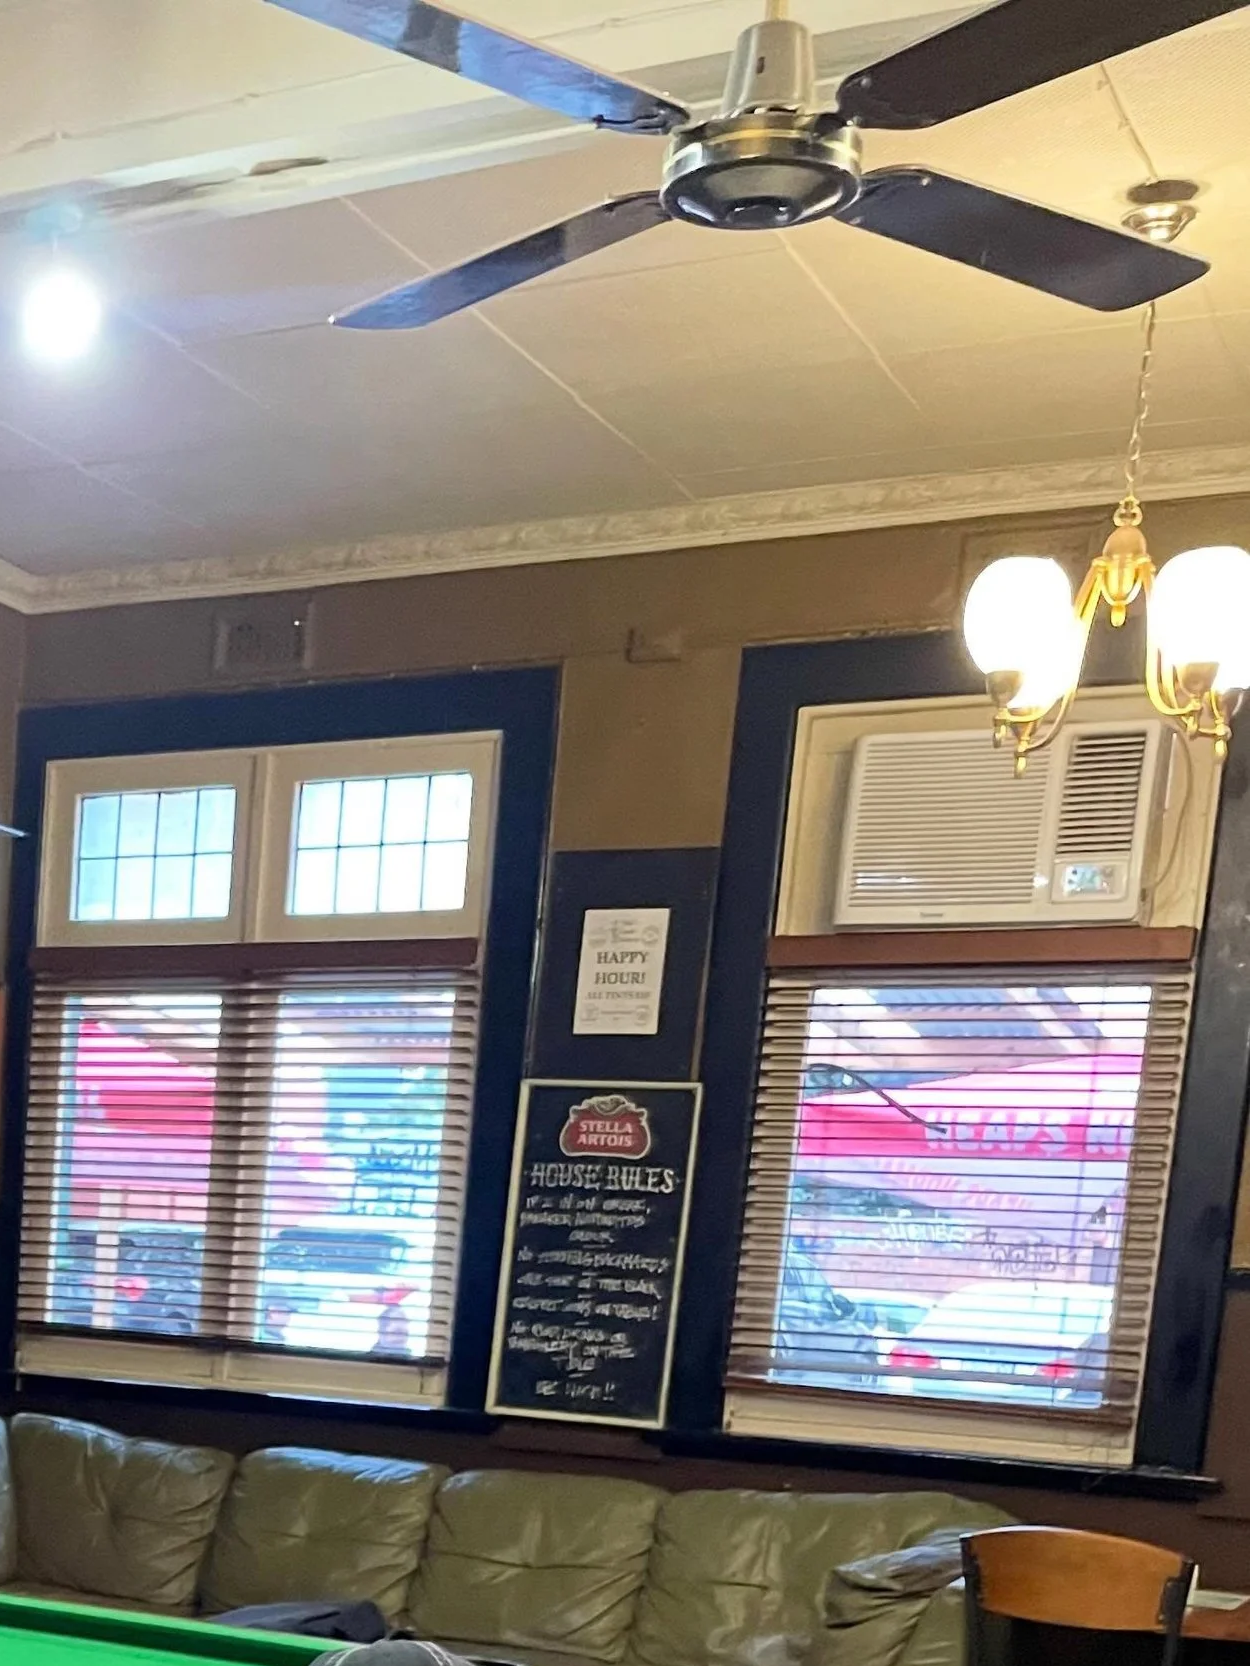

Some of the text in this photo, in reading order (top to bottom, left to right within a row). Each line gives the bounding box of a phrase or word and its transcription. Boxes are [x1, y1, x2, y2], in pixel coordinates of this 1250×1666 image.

[596, 951, 651, 965] HAPPY
[594, 972, 647, 986] HOUR!
[580, 1120, 634, 1134] STELLA
[577, 1133, 634, 1148] ARTOIS
[530, 1163, 676, 1194] HOUSE RULES
